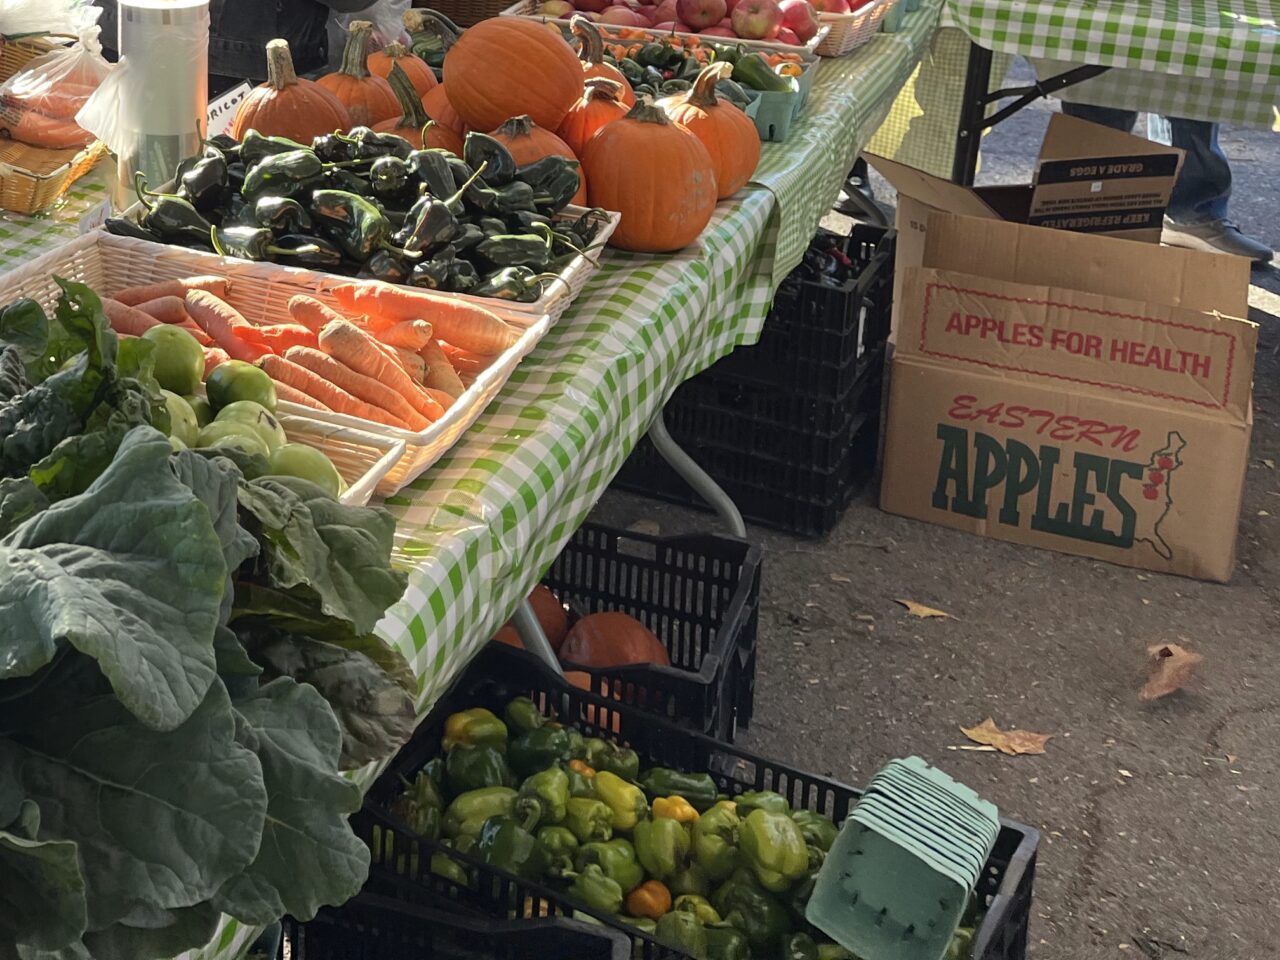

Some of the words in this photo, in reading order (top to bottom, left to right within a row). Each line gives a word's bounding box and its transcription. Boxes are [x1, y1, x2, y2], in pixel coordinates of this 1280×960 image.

[1070, 166, 1099, 177] EGGS
[1099, 165, 1107, 175] A
[1108, 163, 1144, 174] GRADE
[1123, 213, 1151, 224] KEEP
[945, 312, 1044, 348] APPLES
[1051, 328, 1103, 359] FOR
[1109, 339, 1212, 378] HEALTH
[948, 395, 1141, 452] EASTERN
[931, 423, 1144, 549] APPLES
